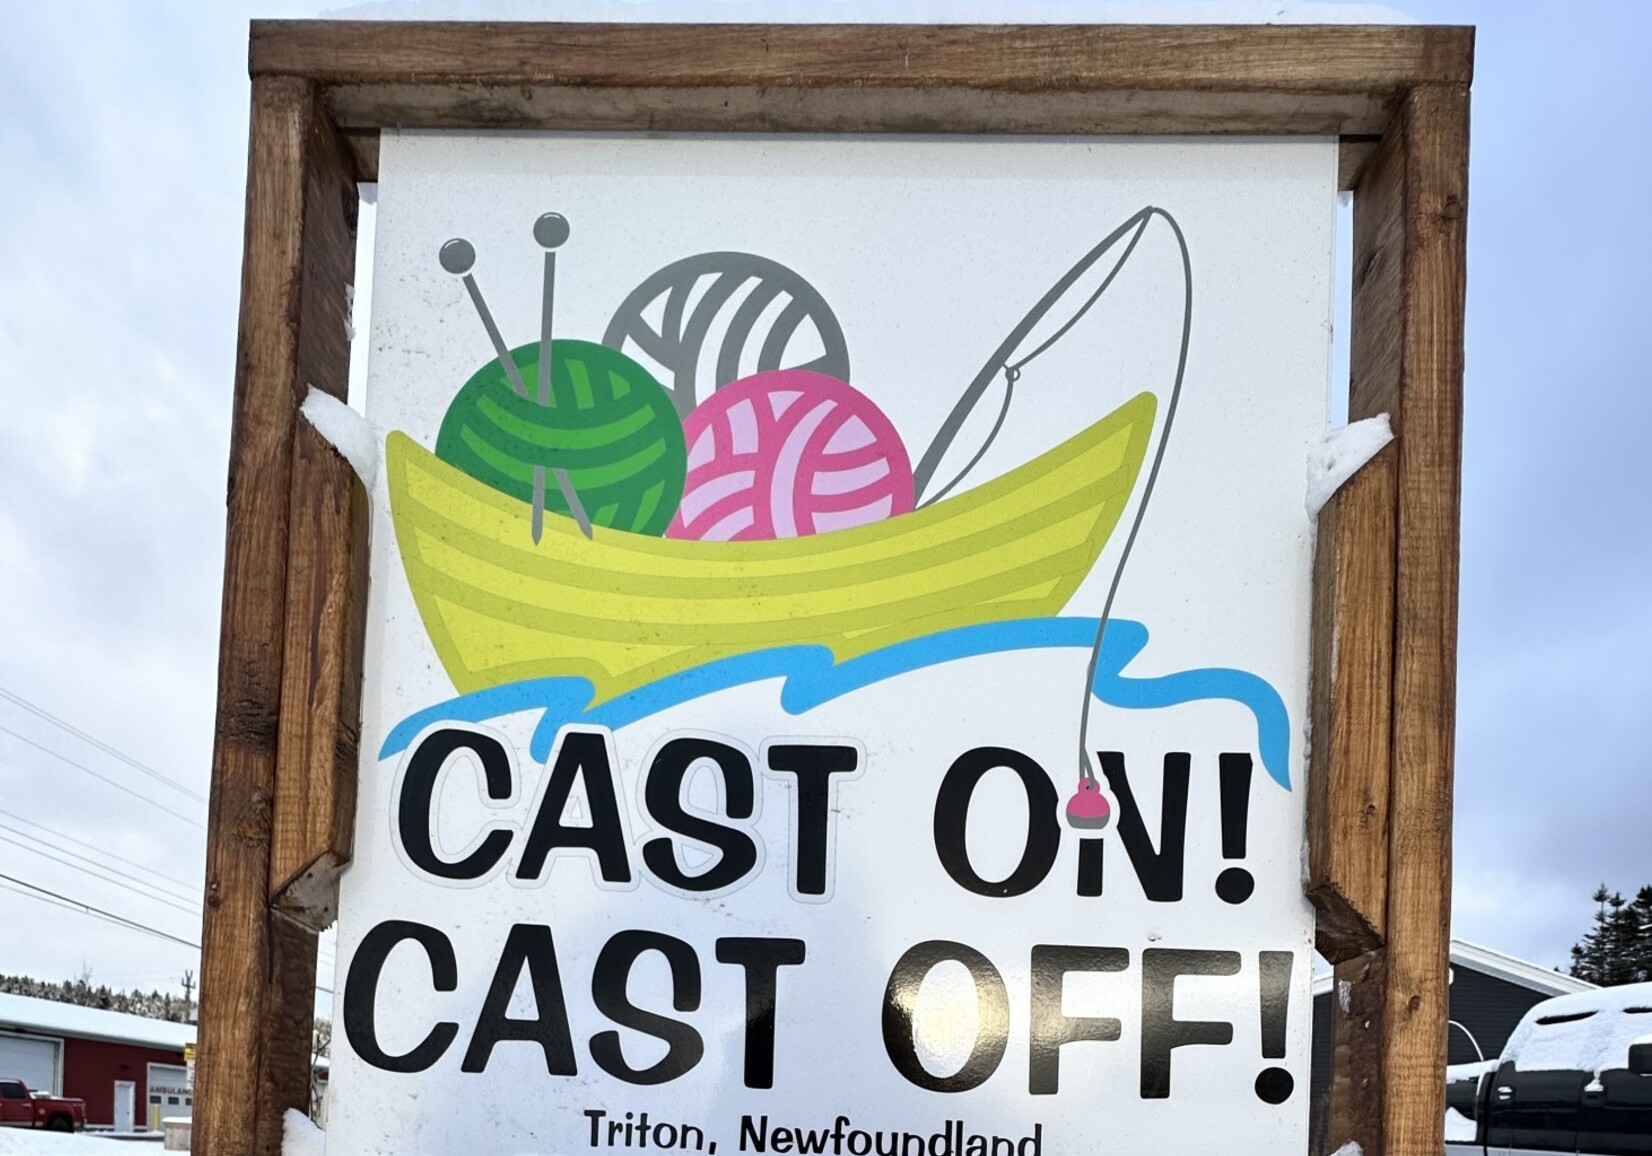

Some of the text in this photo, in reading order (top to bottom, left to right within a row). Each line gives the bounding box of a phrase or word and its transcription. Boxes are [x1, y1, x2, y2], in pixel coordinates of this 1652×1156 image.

[399, 728, 1255, 904] CAST ON!
[343, 919, 1294, 1104] CAST OFF!
[150, 1086, 192, 1096] AMBULANC
[584, 1109, 717, 1155] Triton,
